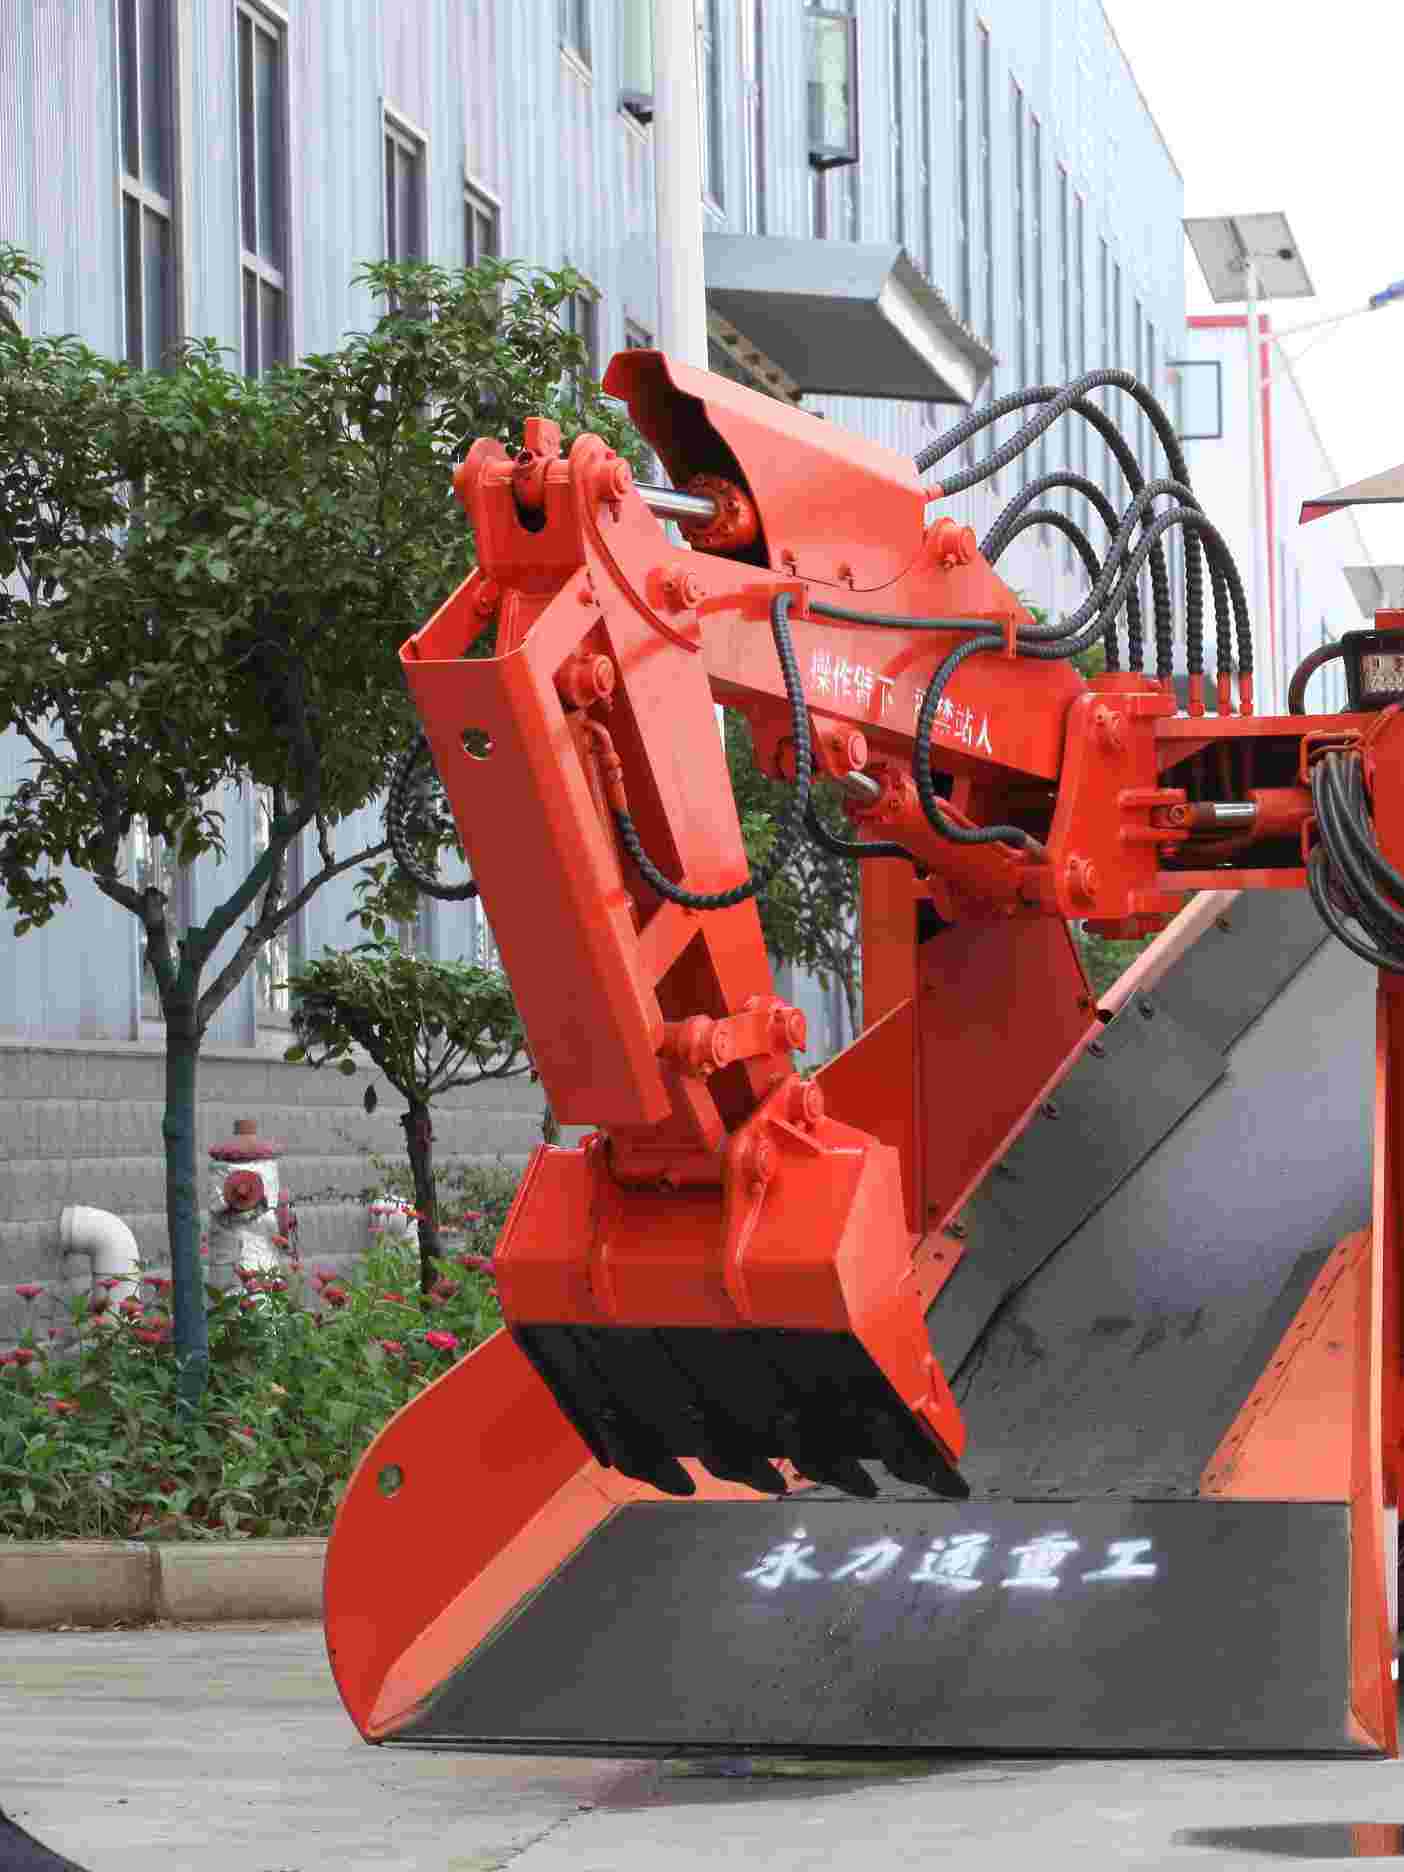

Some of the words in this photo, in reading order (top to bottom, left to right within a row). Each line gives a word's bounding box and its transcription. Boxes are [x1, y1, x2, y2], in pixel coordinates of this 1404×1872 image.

[743, 1528, 1159, 1590] 永力通重工
